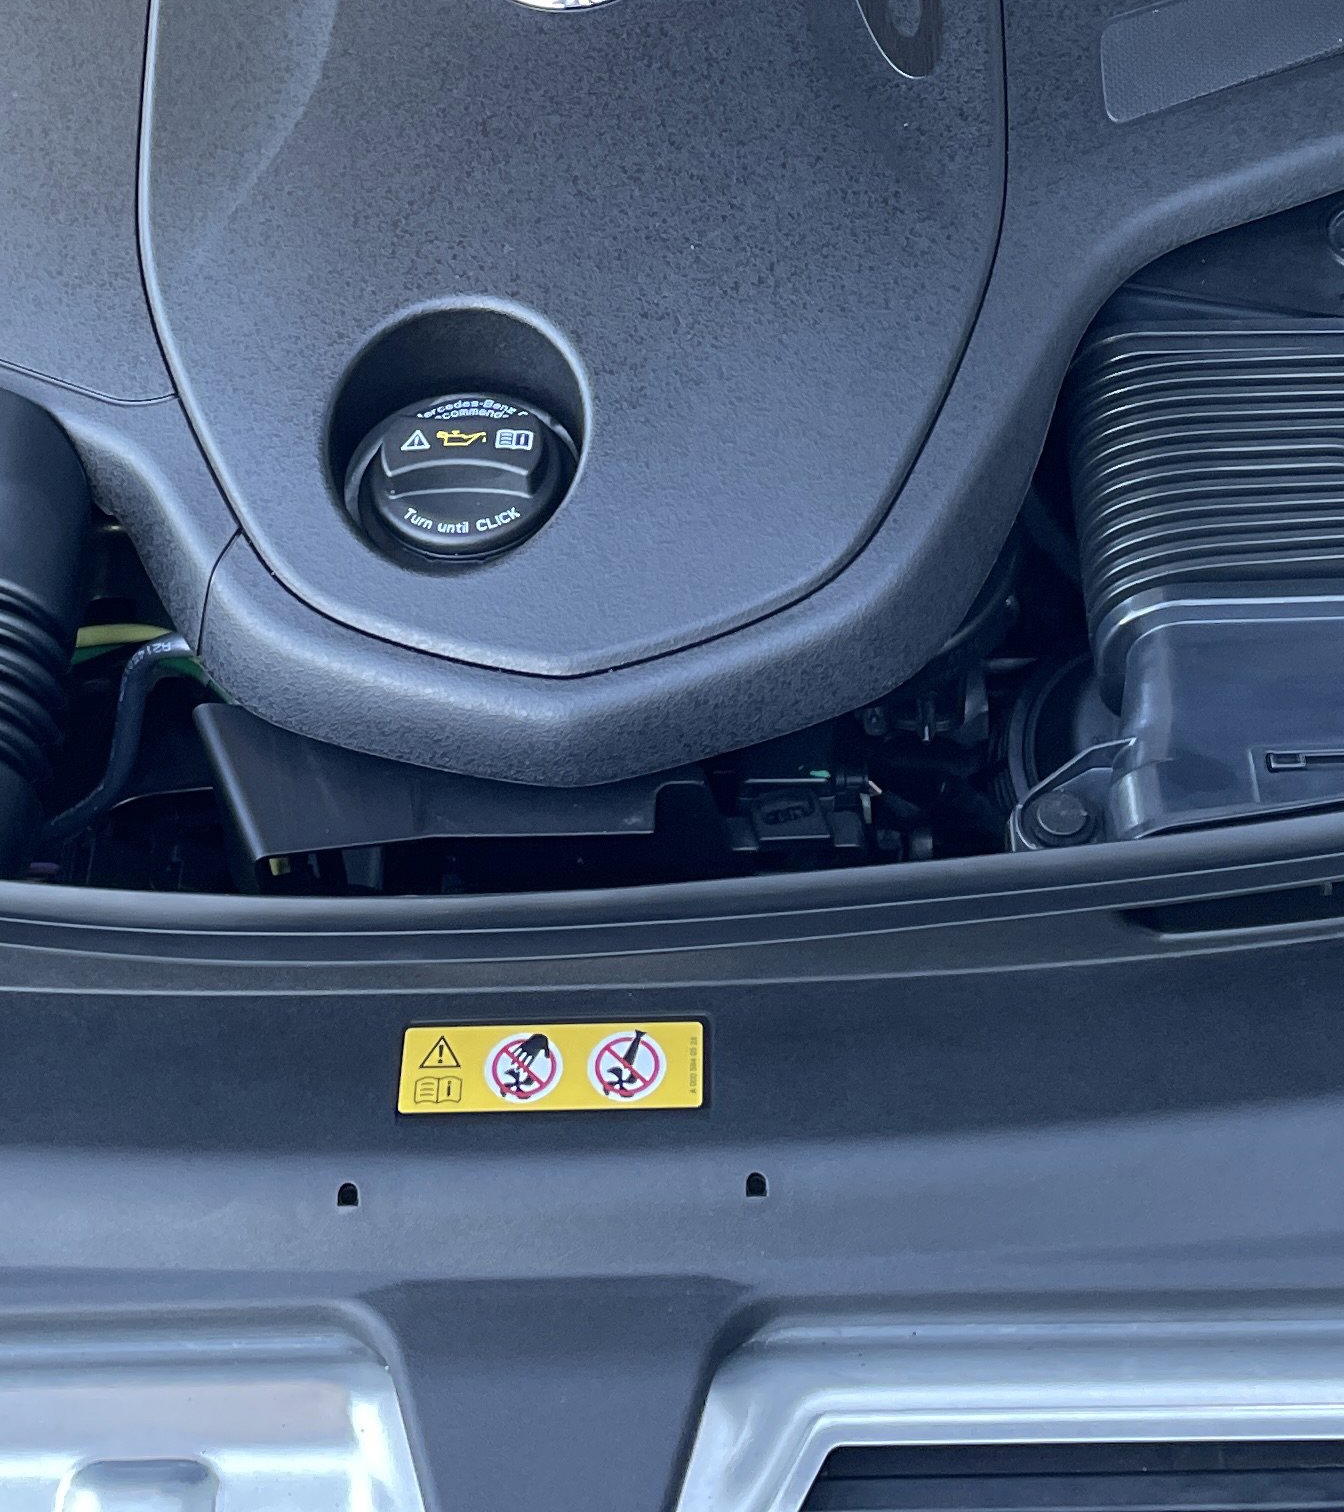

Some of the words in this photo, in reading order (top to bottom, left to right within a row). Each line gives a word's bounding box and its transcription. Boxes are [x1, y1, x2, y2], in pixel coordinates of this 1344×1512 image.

[403, 508, 432, 530] Turn
[437, 521, 469, 534] until
[476, 507, 521, 532] CLICK
